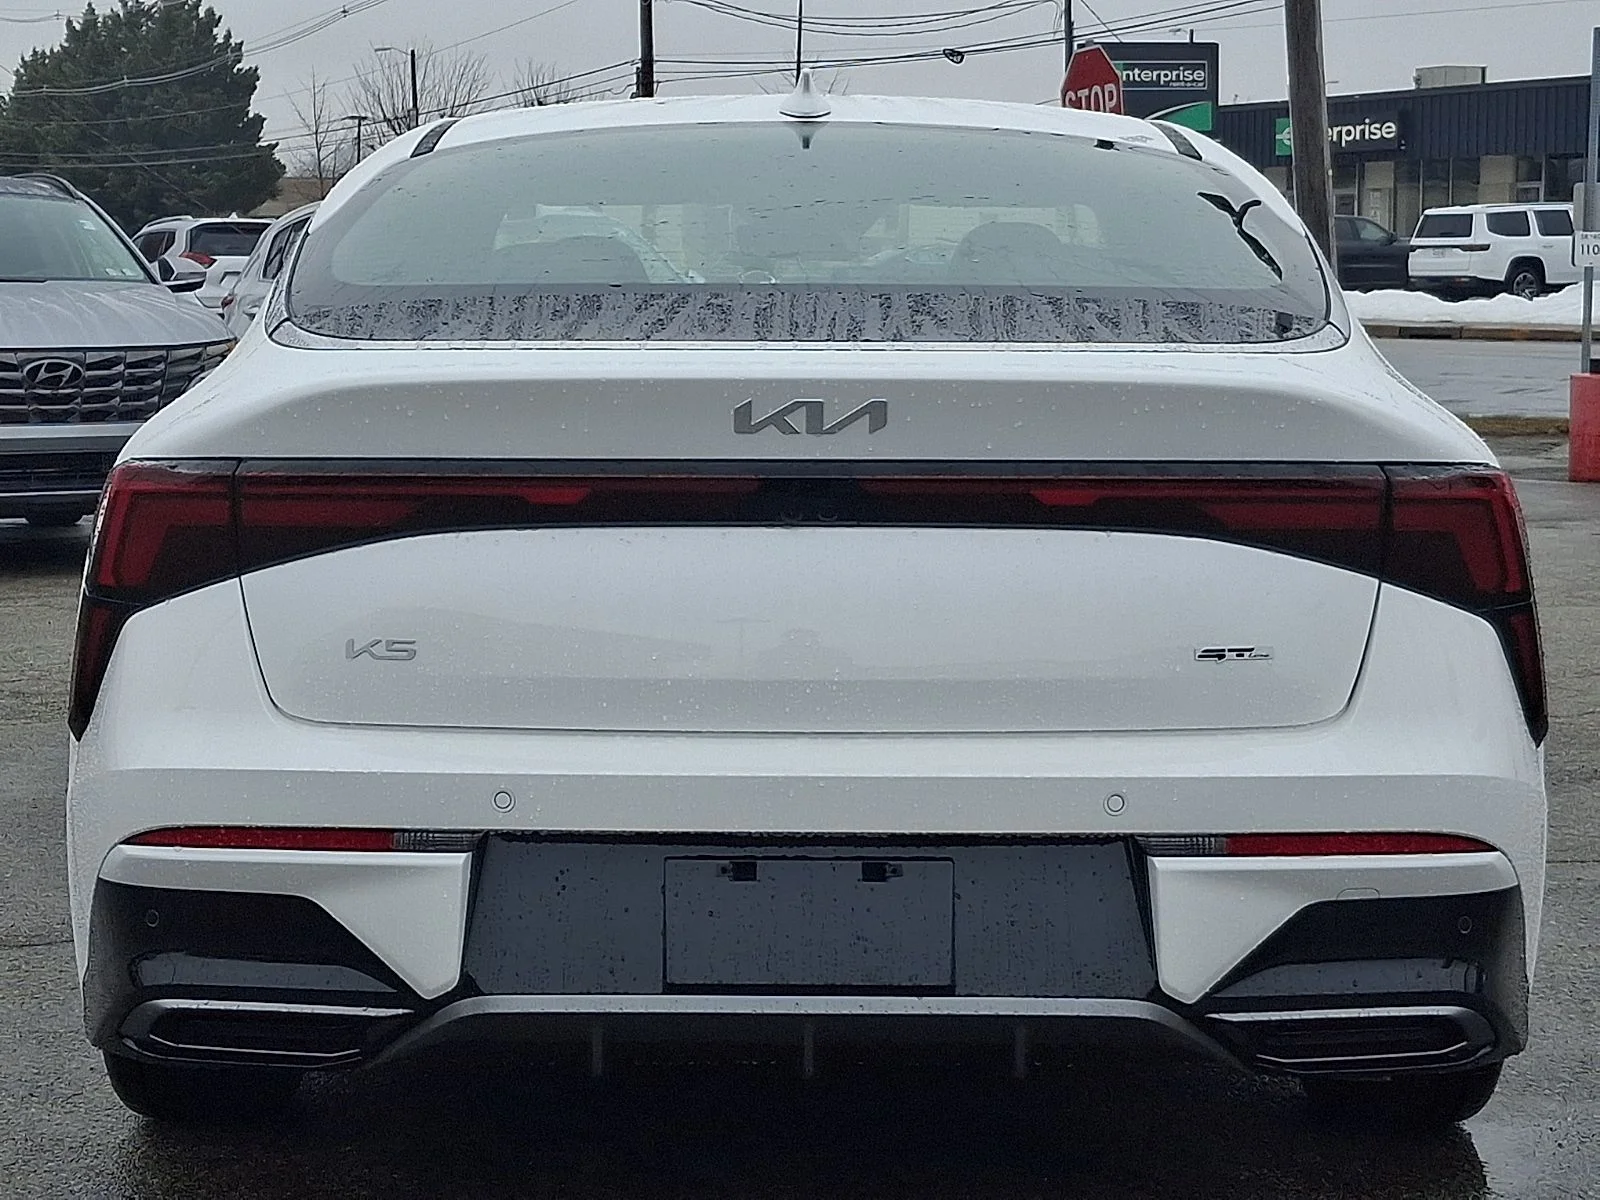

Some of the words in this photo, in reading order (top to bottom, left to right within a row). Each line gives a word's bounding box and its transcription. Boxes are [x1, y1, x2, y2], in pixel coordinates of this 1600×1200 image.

[1117, 66, 1205, 85] nterprise
[734, 398, 887, 435] KIA
[345, 638, 417, 660] K5
